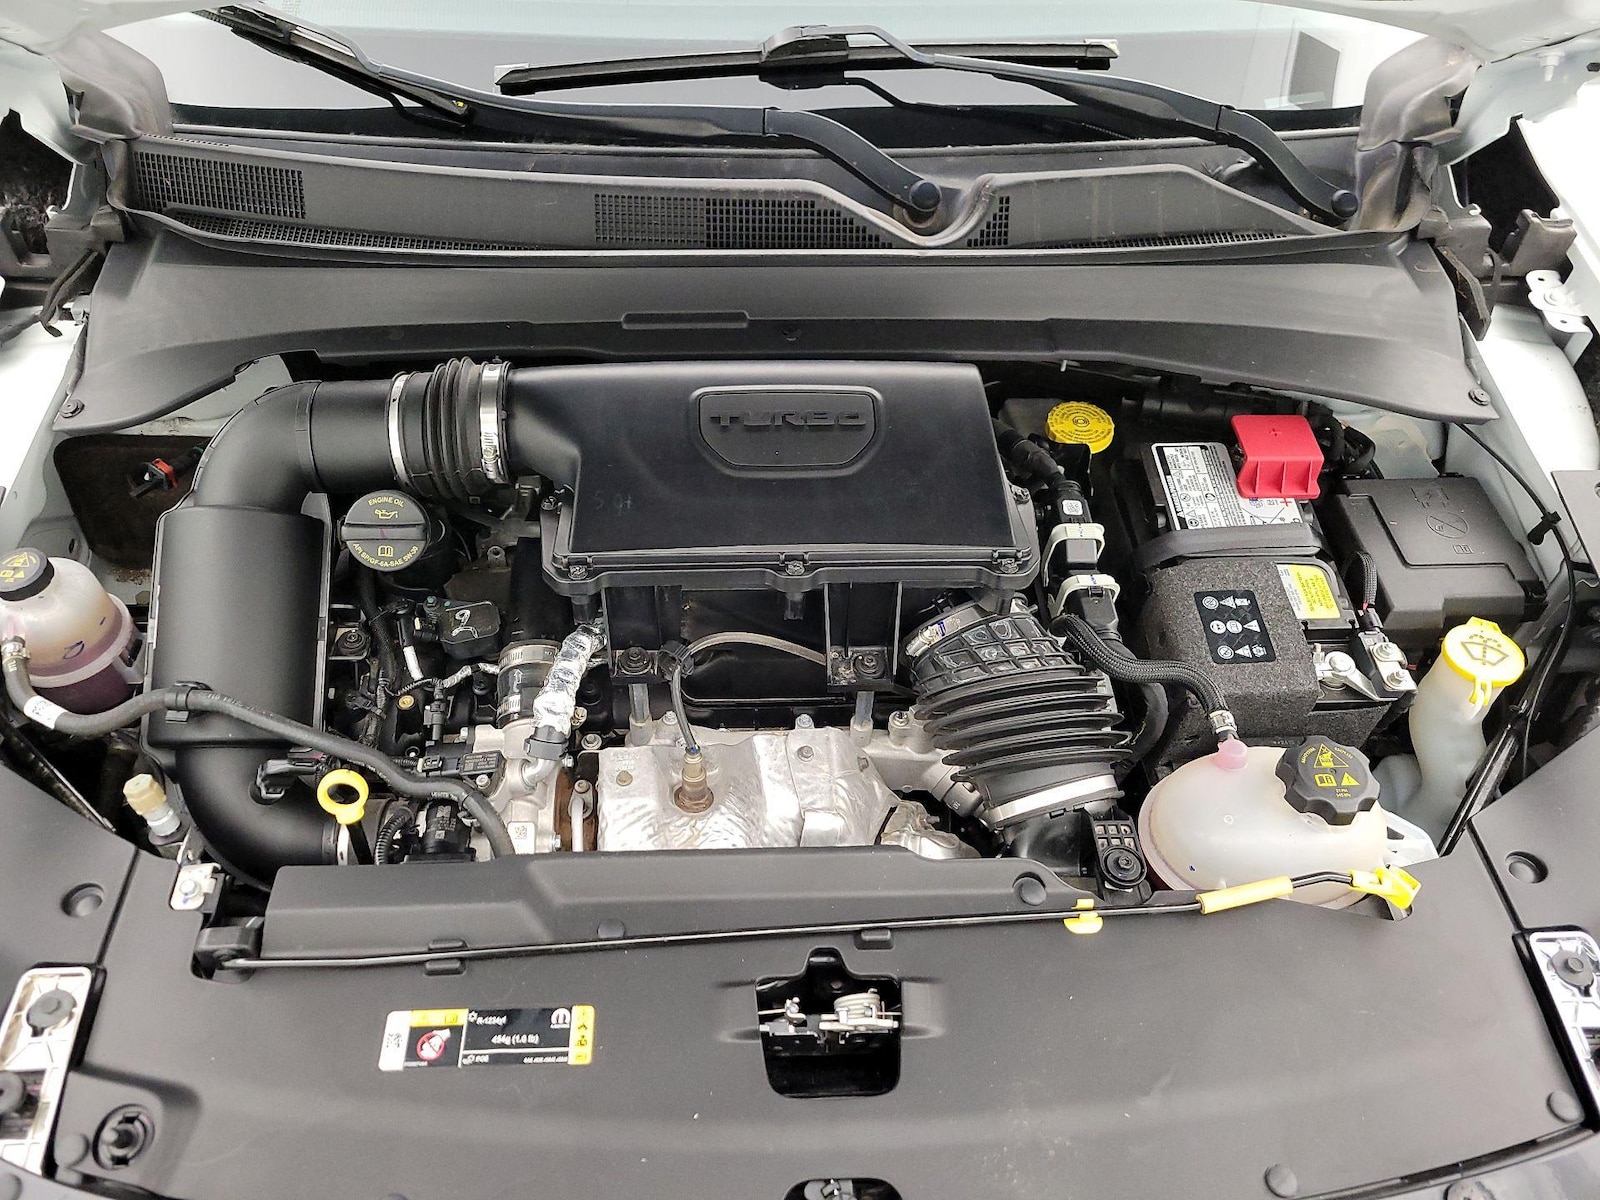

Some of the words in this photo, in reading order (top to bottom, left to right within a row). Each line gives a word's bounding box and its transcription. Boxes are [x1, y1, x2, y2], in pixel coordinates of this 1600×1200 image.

[710, 409, 867, 430] TURBO
[368, 496, 393, 506] ENGINE
[394, 497, 405, 508] OIL
[352, 543, 362, 554] API
